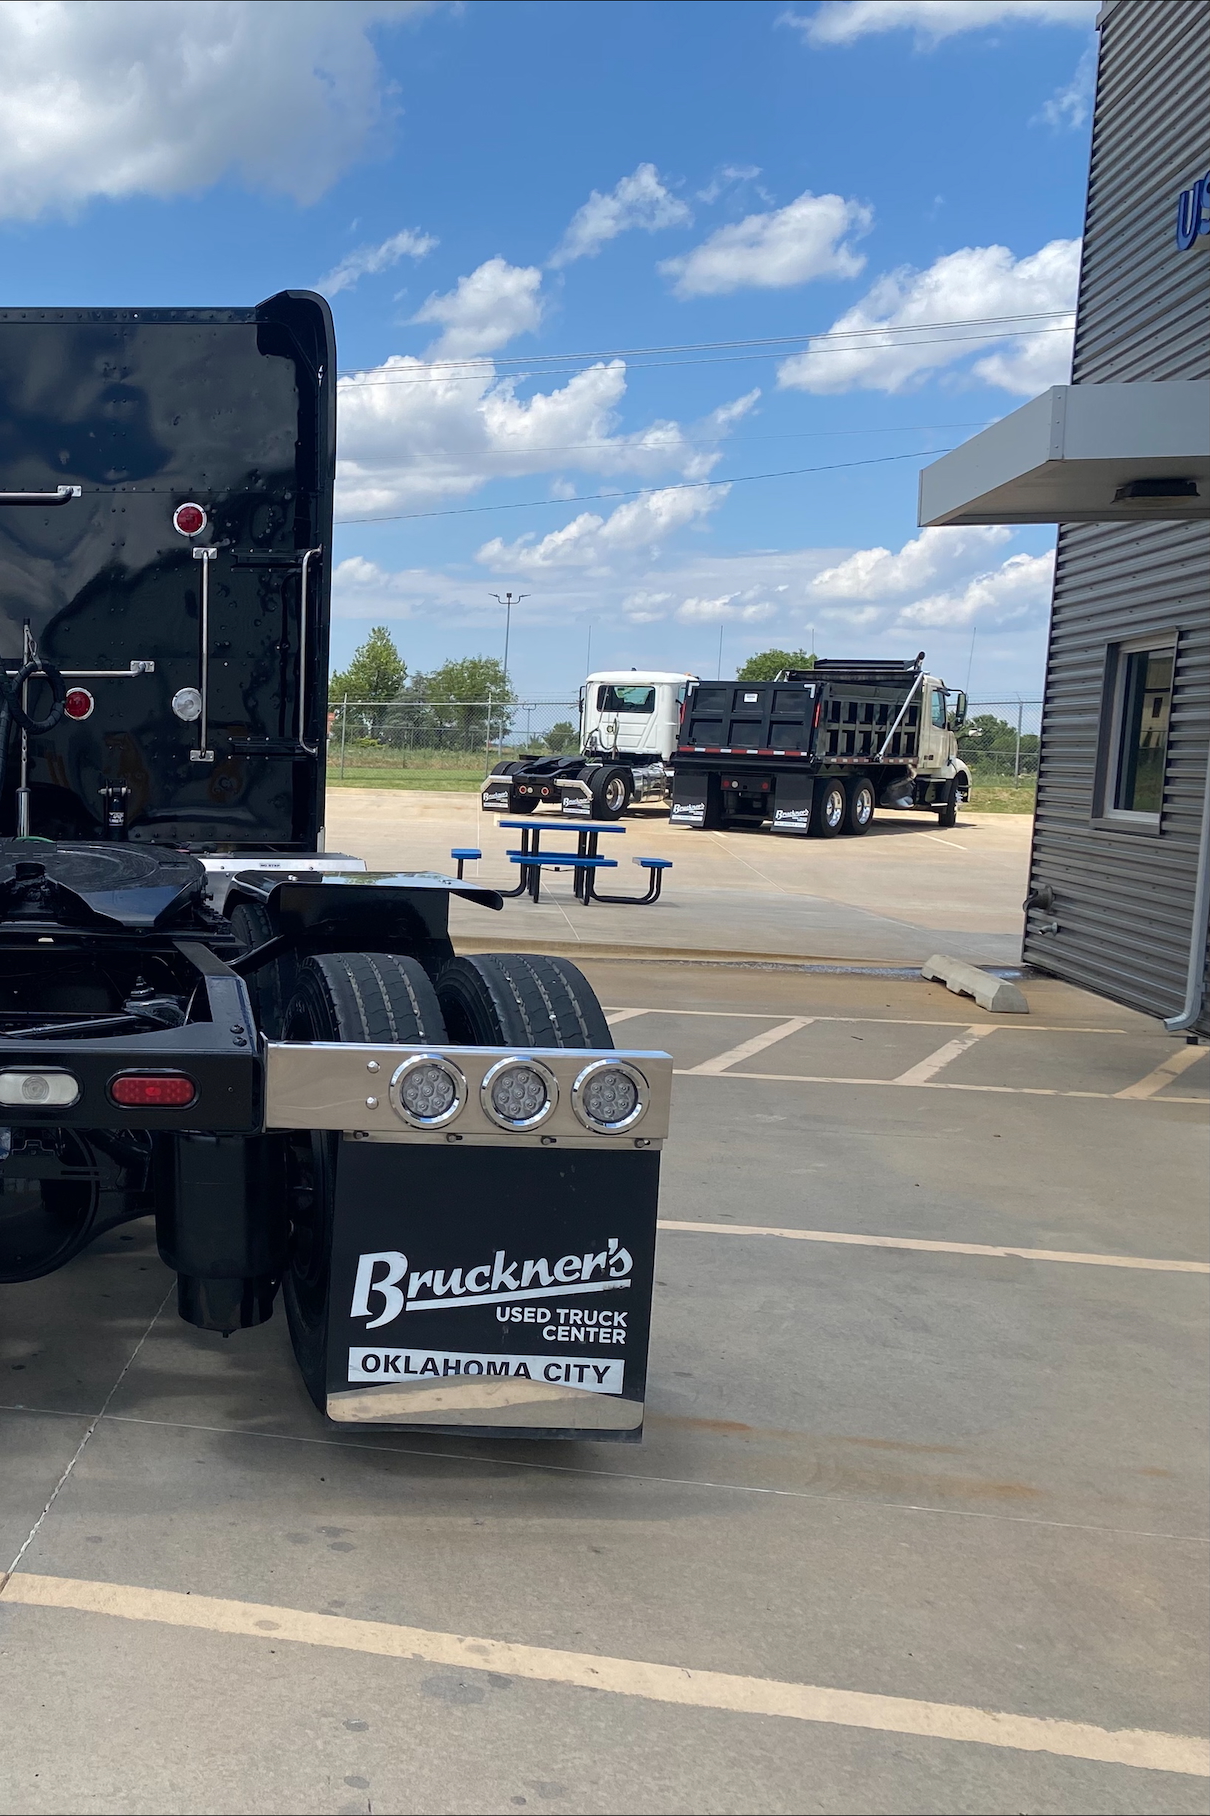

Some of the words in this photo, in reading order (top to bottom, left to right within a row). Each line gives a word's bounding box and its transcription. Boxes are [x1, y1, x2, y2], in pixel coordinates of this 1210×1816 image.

[350, 1237, 633, 1329] Bruckner's
[495, 1306, 551, 1324] USED
[556, 1308, 628, 1327] TRUCK
[542, 1325, 626, 1345] CENTER
[361, 1353, 532, 1380] OKLAHOMA
[543, 1362, 611, 1384] CITY
